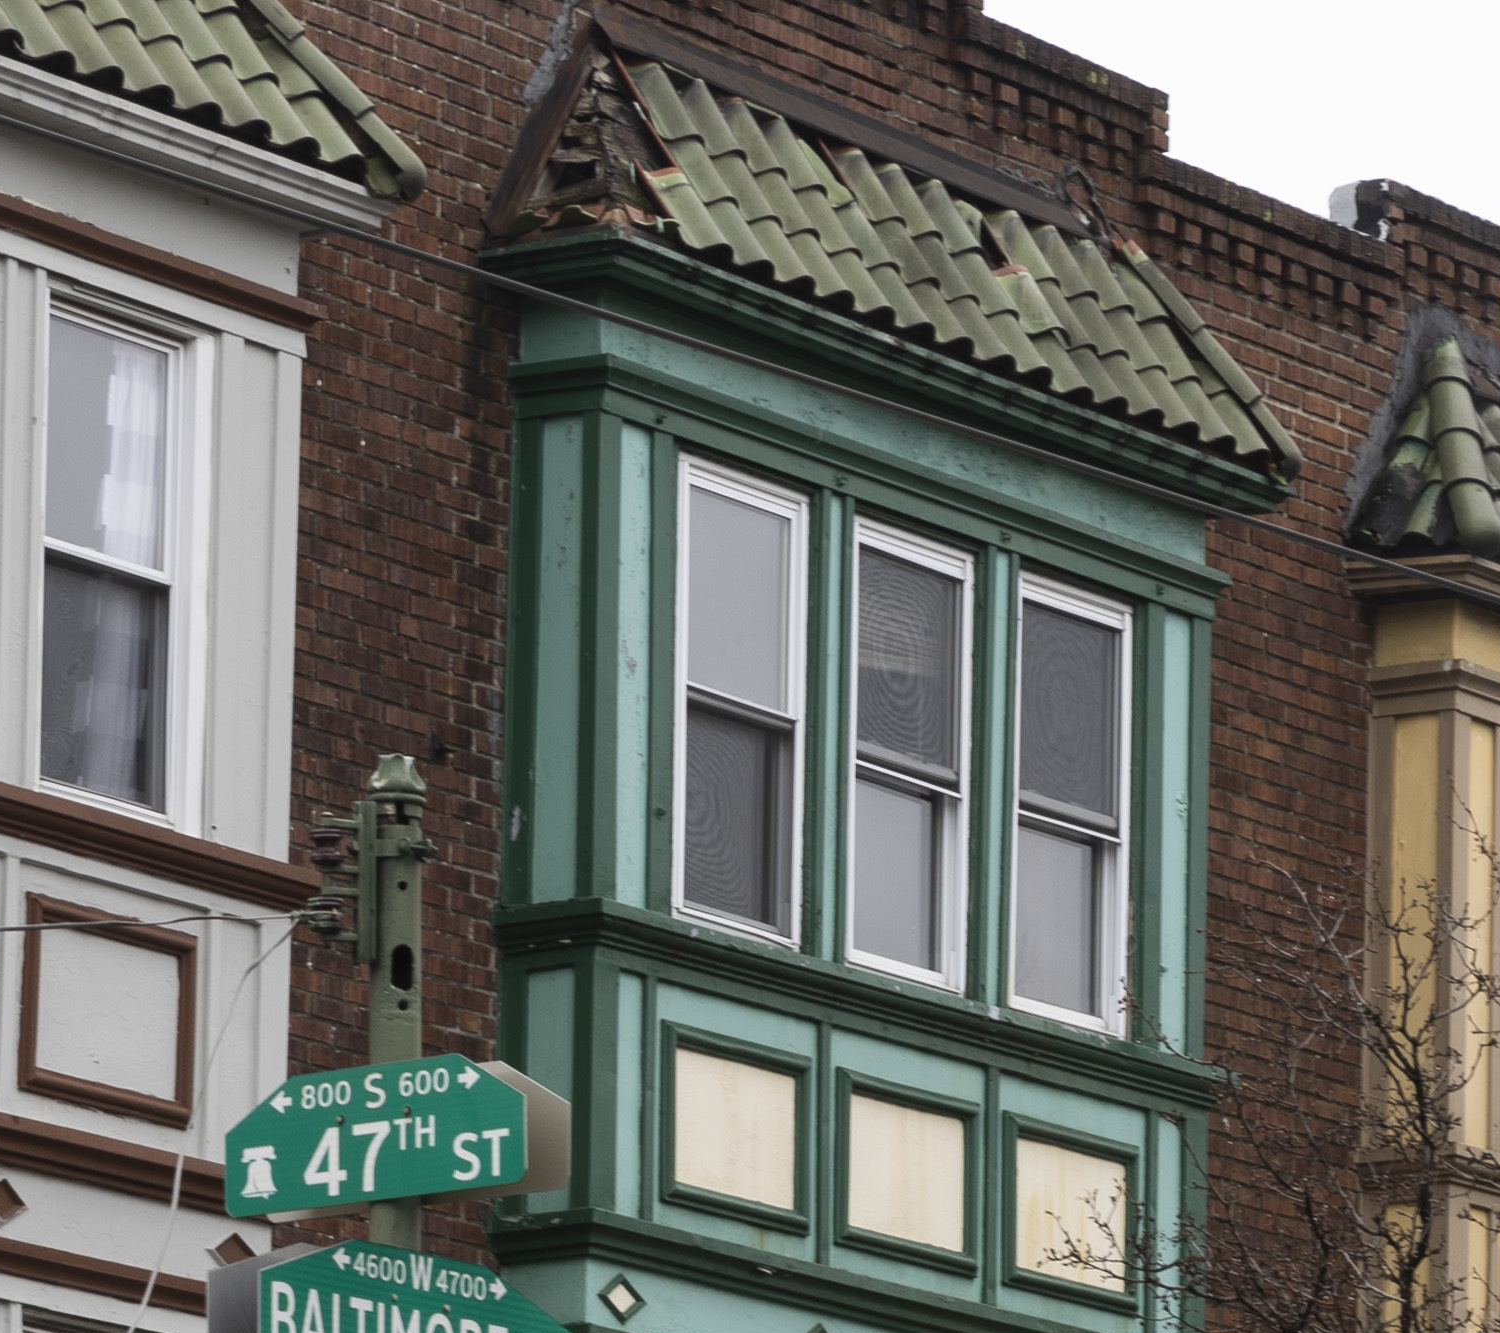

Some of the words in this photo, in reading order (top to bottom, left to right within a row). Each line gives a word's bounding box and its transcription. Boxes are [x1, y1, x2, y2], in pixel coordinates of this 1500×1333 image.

[300, 1081, 351, 1111] 800
[364, 1072, 387, 1109] S
[399, 1067, 450, 1097] 600
[303, 1114, 437, 1197] 47TH
[451, 1128, 510, 1182] ST
[352, 1255, 406, 1284] 4600
[410, 1254, 434, 1292] W
[436, 1270, 488, 1301] 4700
